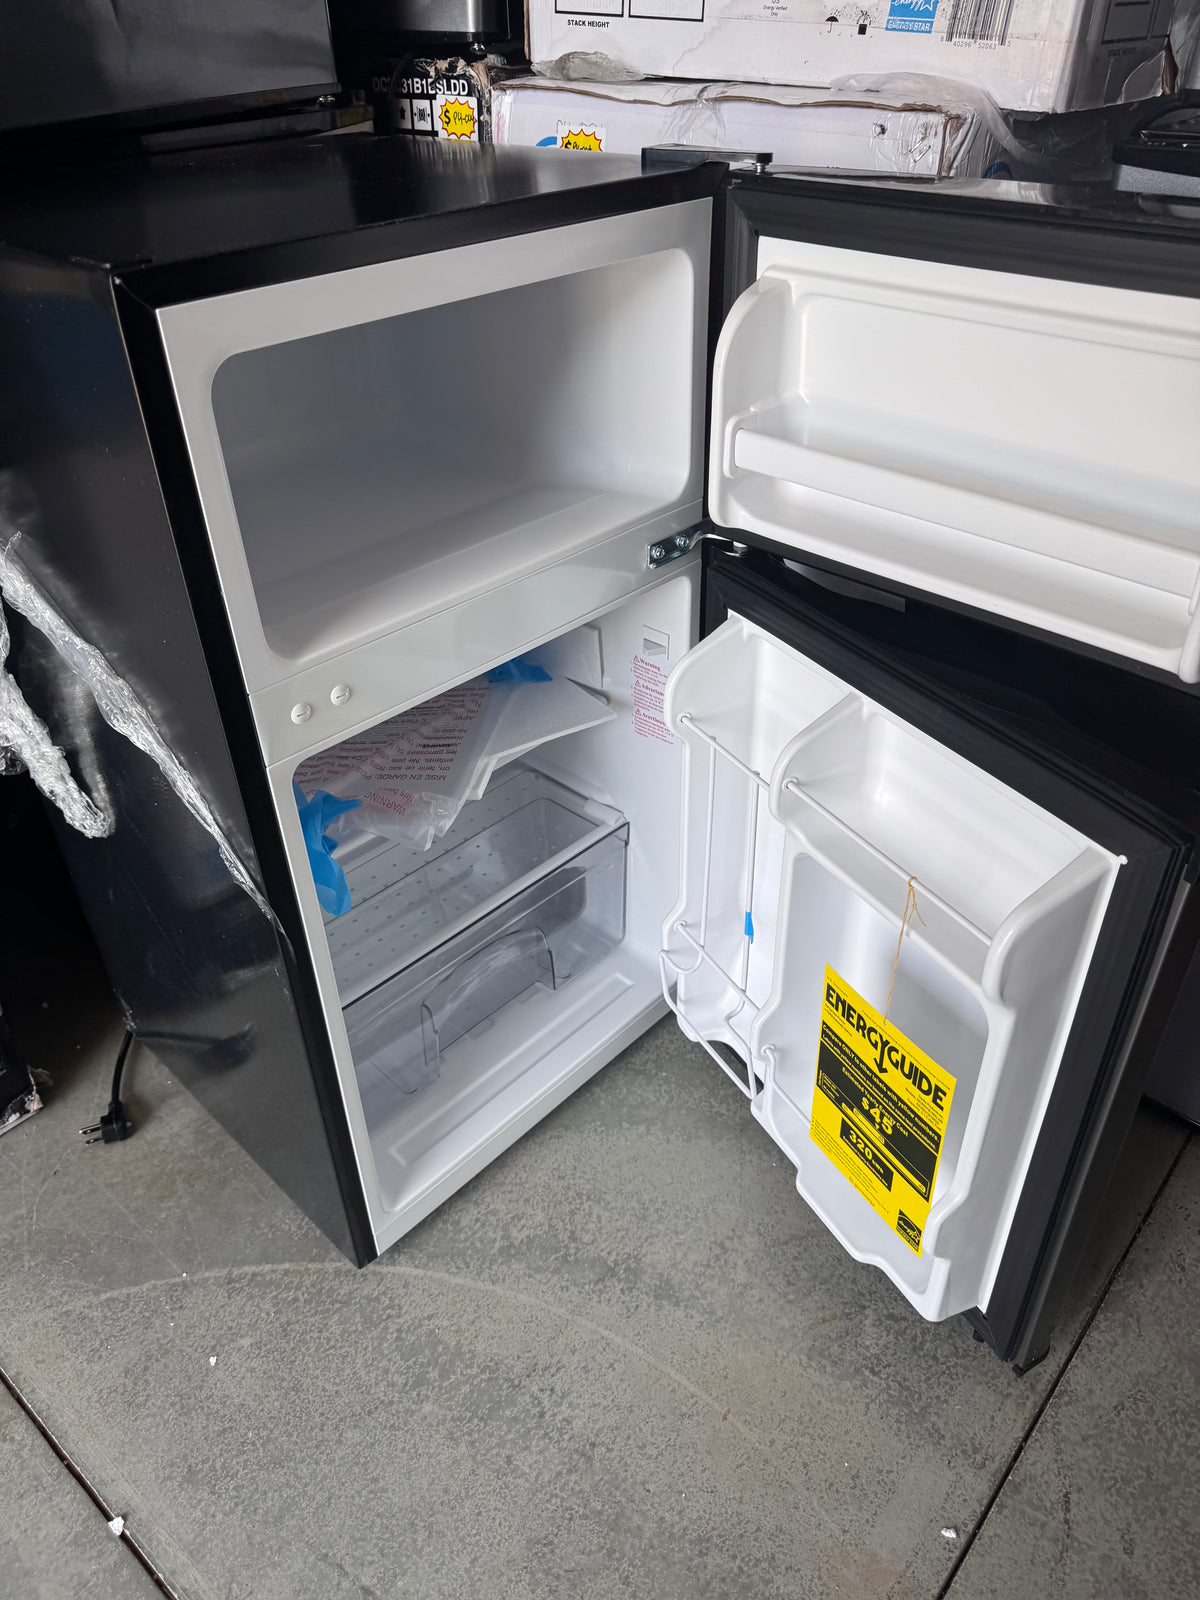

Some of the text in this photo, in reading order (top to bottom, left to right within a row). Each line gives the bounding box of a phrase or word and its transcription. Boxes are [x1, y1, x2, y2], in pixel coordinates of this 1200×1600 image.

[588, 20, 610, 28] HEIGHT
[888, 20, 930, 31] ENERGY STAR
[446, 108, 451, 127] $
[825, 982, 947, 1112] ENERGYGUIDE
[822, 1023, 841, 1047] Compare
[841, 1042, 854, 1059] ONLY
[854, 1056, 859, 1065] to
[859, 1061, 871, 1077] other
[871, 1073, 886, 1092] labels
[886, 1088, 897, 1103] with
[897, 1098, 914, 1120] yellow
[914, 1114, 940, 1143] numbers.
[841, 1065, 909, 1138] Estimated Yearly Energy Cost
[860, 1093, 893, 1137] $45
[848, 1128, 883, 1174] 320 kWh
